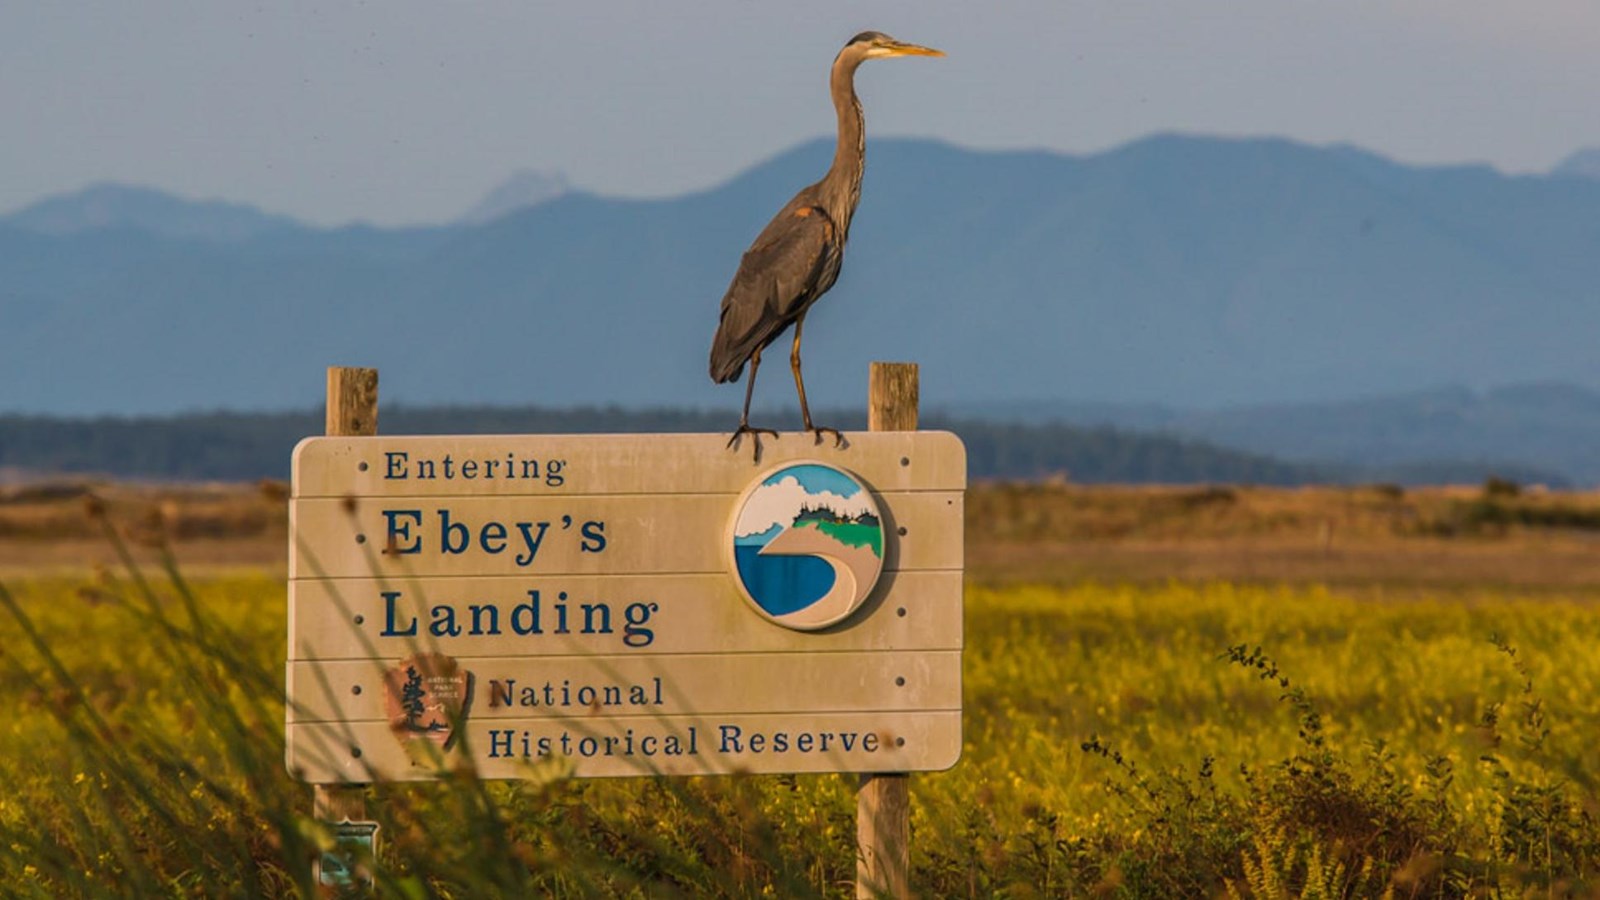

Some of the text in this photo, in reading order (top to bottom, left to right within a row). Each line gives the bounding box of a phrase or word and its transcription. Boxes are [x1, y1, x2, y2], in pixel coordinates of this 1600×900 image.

[384, 452, 567, 487] Entering
[382, 509, 607, 566] Ebey's
[380, 590, 659, 647] Landing
[489, 678, 664, 708] National
[488, 725, 880, 758] Historical Reserve
